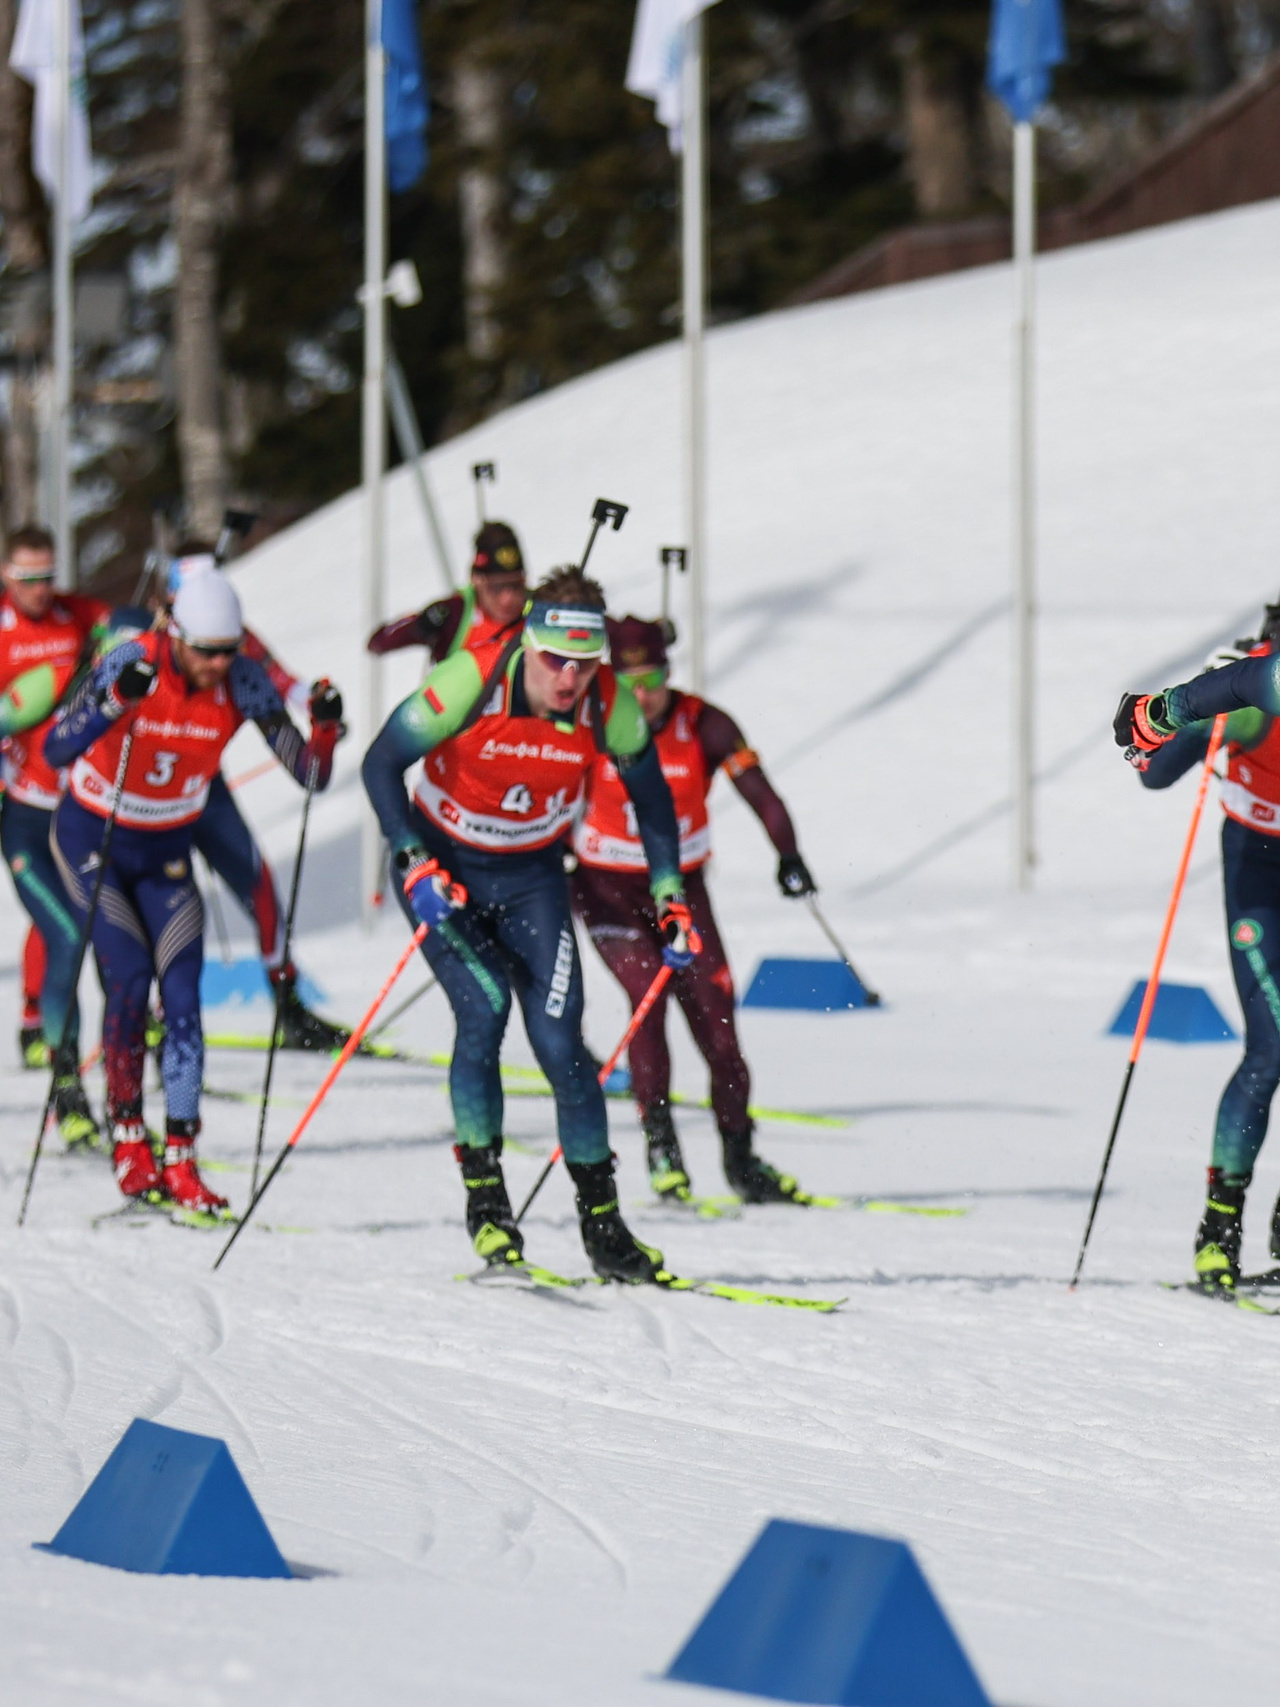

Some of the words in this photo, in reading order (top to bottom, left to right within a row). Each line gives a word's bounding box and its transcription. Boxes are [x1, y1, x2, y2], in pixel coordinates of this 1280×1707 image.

[479, 738, 540, 760] Альфа
[541, 743, 584, 764] Банк
[145, 751, 180, 788] 3
[500, 784, 534, 814] 4
